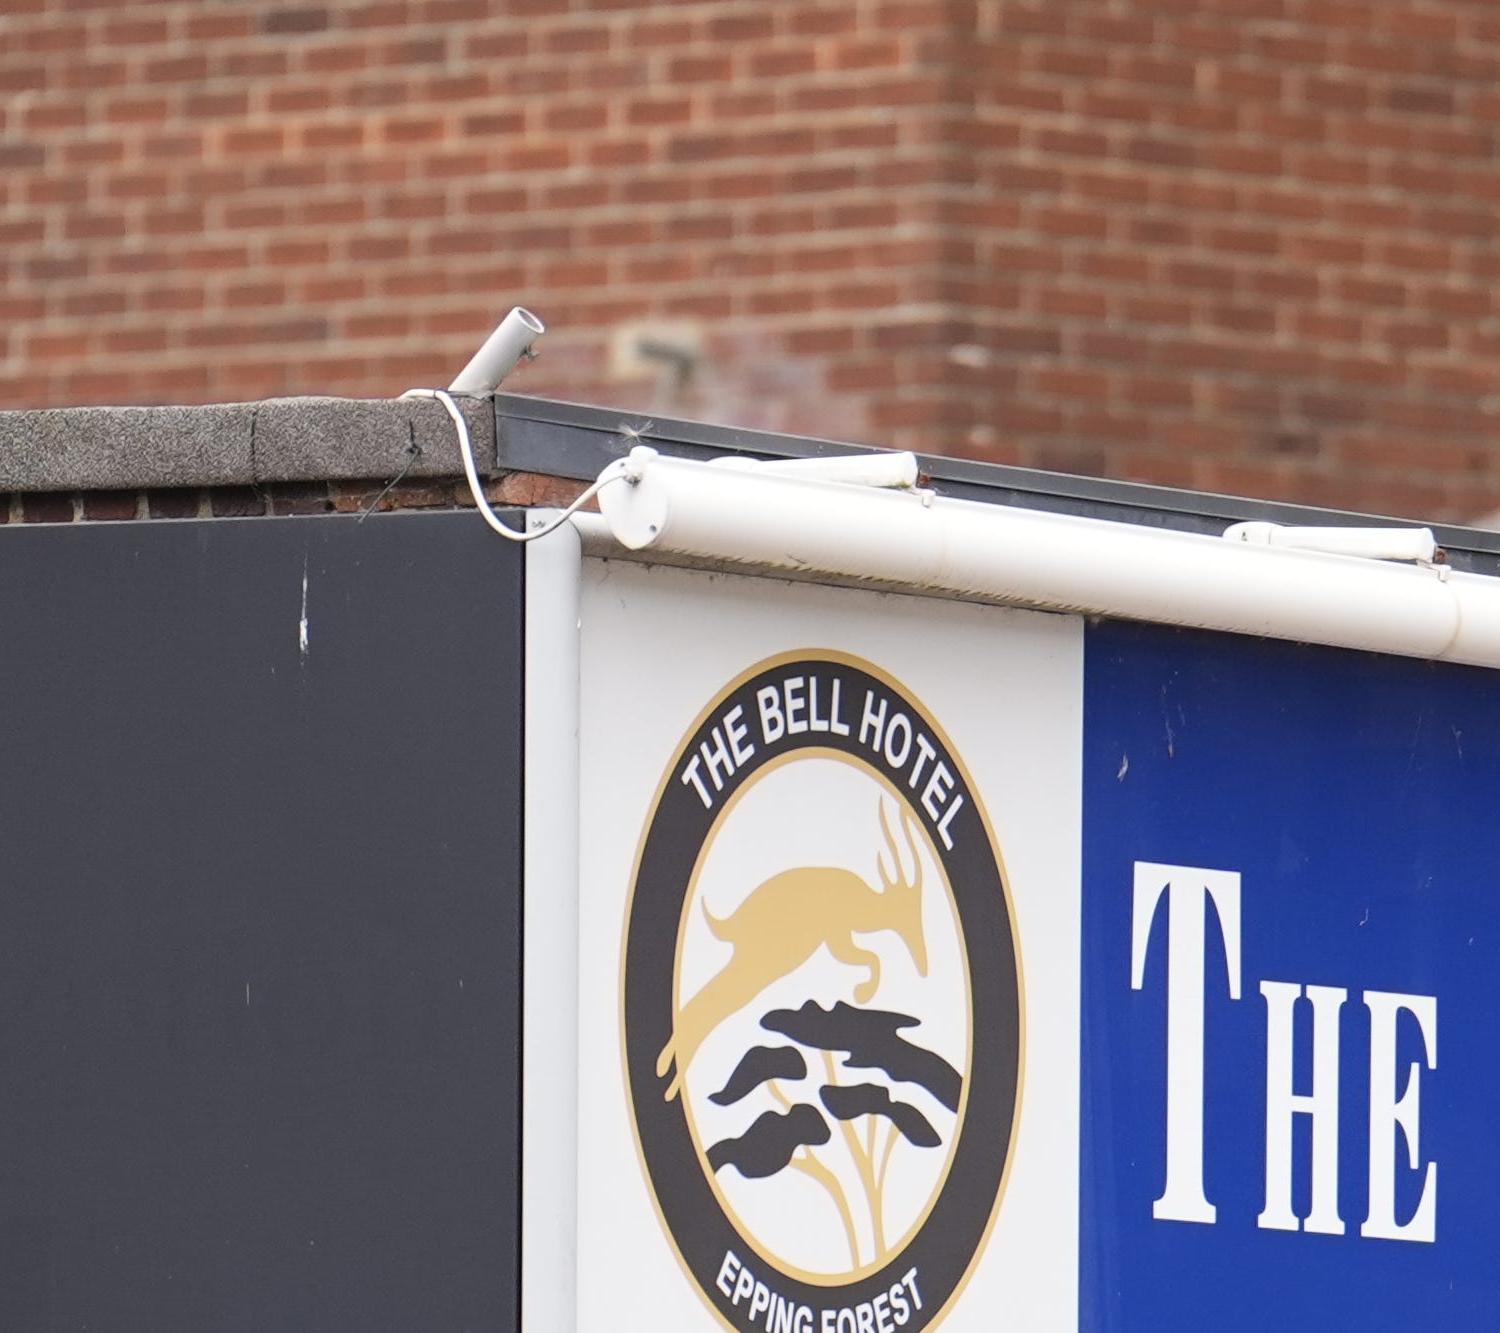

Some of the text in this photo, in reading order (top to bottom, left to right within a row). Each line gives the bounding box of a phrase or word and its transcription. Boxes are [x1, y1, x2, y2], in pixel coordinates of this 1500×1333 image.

[681, 676, 964, 850] THE BELL HOTEL
[1132, 861, 1436, 1242] THE
